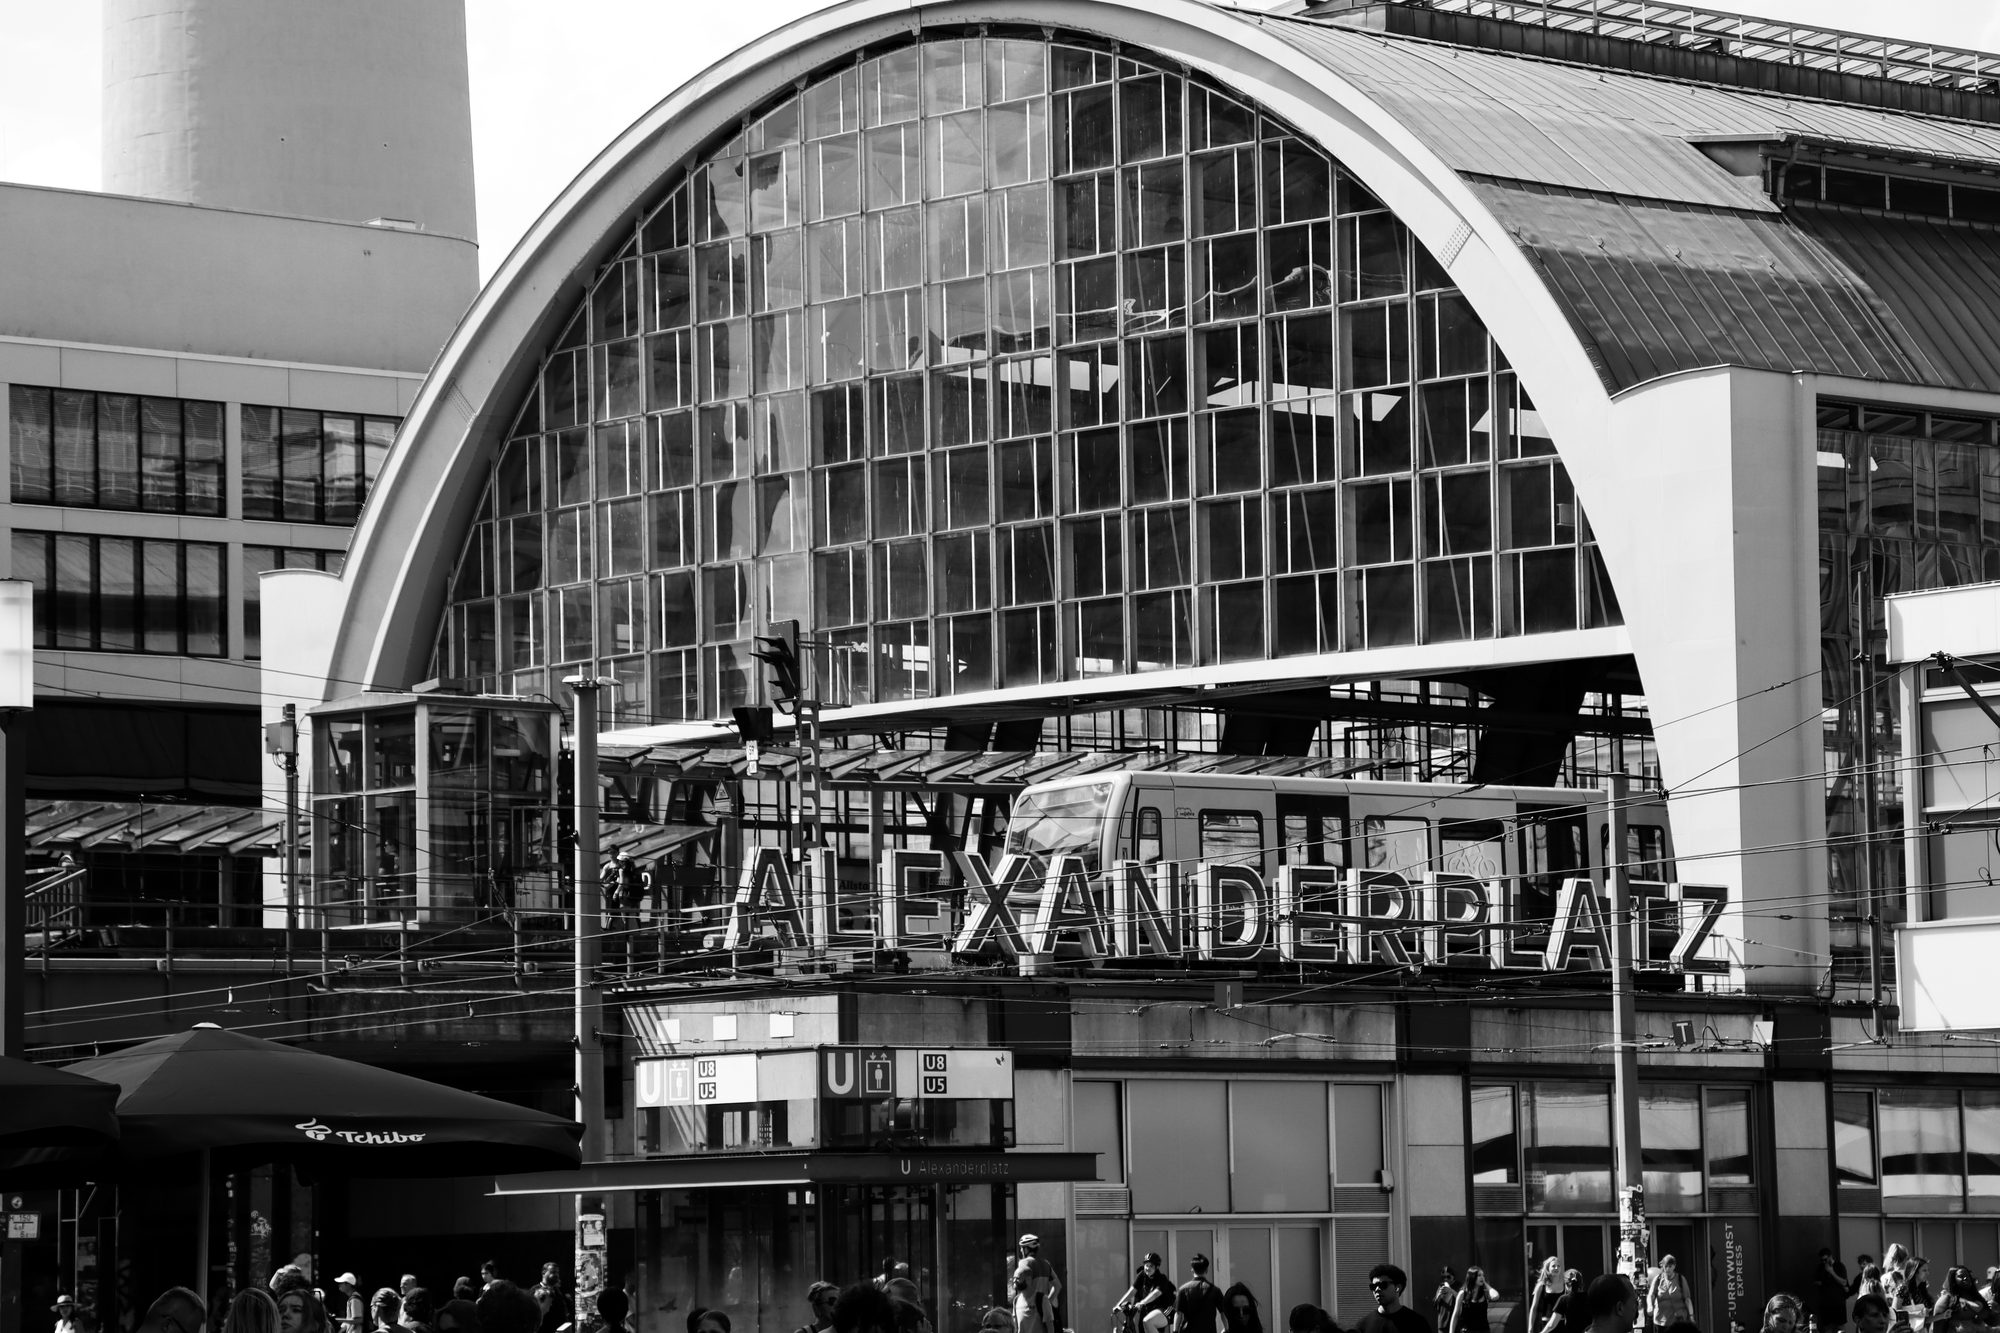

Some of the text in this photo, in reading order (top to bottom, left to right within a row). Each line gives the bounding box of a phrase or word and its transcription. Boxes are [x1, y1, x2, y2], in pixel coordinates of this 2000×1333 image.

[723, 845, 1730, 977] ALEXANDERPLATZ
[700, 1061, 716, 1077] U8
[926, 1055, 945, 1070] U8
[827, 1052, 854, 1095] U
[639, 1062, 661, 1104] U
[700, 1083, 716, 1098] U5
[926, 1078, 945, 1092] U5
[335, 1131, 426, 1145] Tchibo
[901, 1159, 1009, 1176] U Alexanderplatz
[1735, 1244, 1745, 1297] EXPRESS
